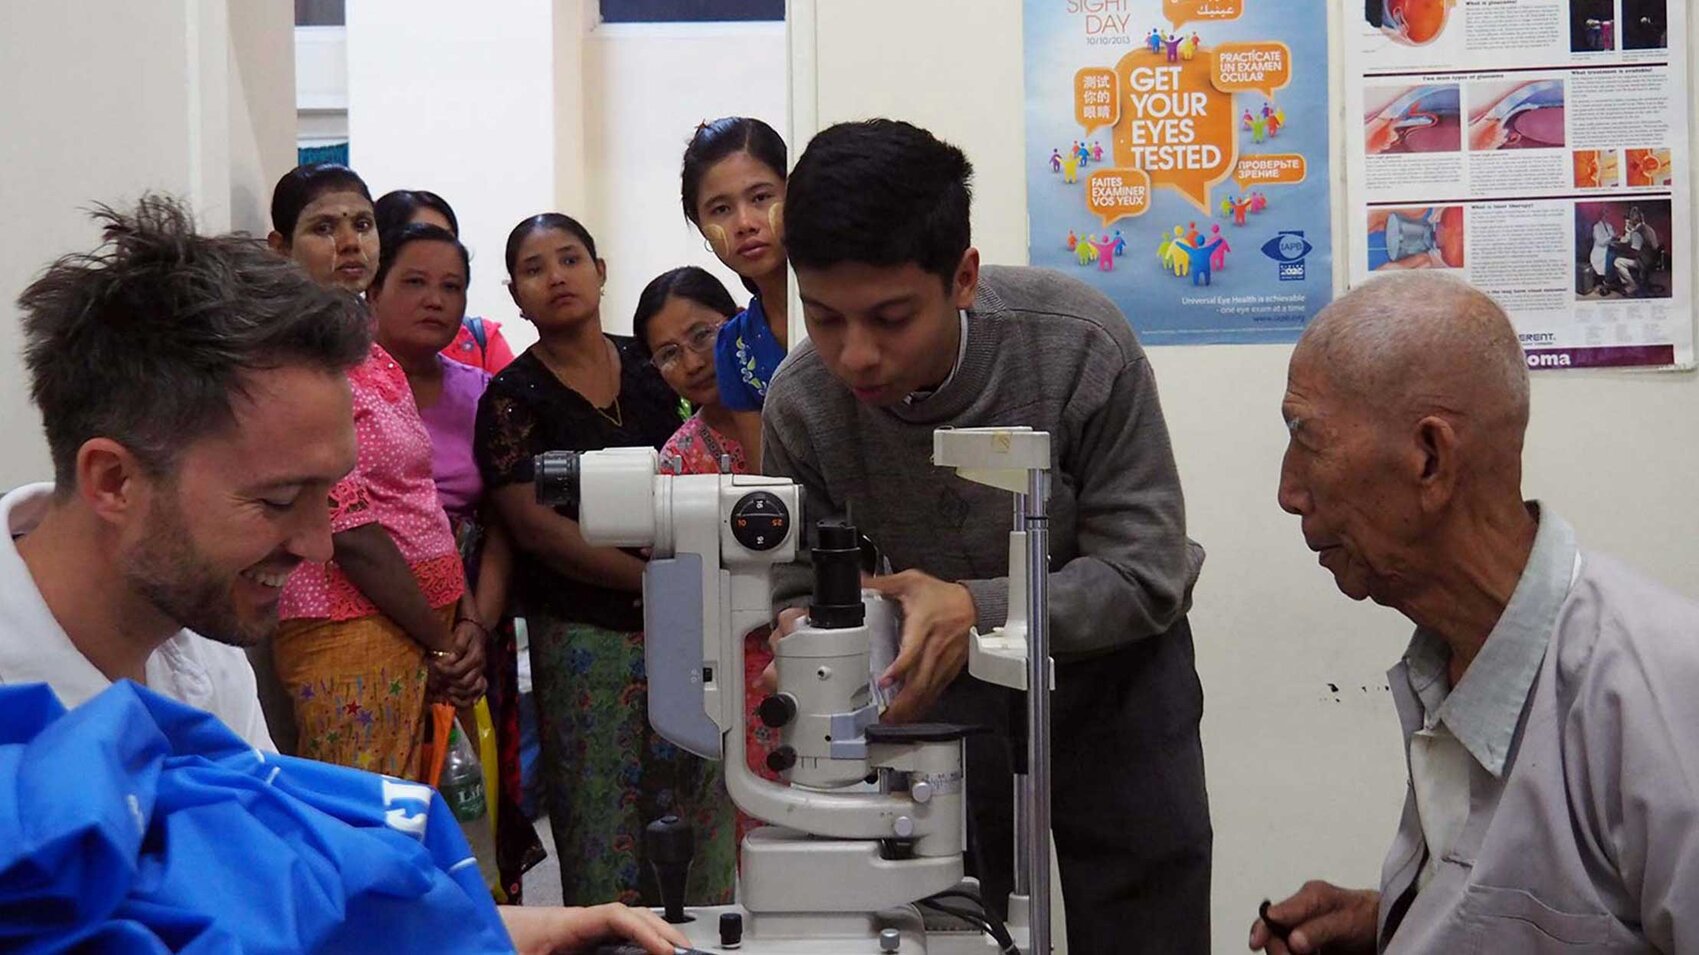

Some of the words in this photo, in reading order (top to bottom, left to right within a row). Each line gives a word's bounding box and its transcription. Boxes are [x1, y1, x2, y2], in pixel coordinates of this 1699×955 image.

[1067, 0, 1128, 13] SIGHT
[1085, 13, 1131, 34] DAY
[1086, 36, 1131, 45] 10/10/2013
[1219, 49, 1281, 62] PRACTÍCATE
[1220, 62, 1235, 73] UN
[1237, 61, 1282, 72] EXAMEN
[1129, 66, 1183, 92] GET
[1219, 71, 1264, 82] OCULAR
[1083, 89, 1110, 104] 你的
[1129, 92, 1208, 118] YOUR
[1132, 118, 1196, 145] EYES
[1131, 144, 1222, 171] TESTED
[1238, 159, 1300, 170] ПРОВЕРЬТЕ
[1237, 169, 1280, 179] ЗРЕНИЕ
[1092, 176, 1123, 187] FAITES
[1092, 186, 1145, 197] EXAMINER
[1092, 197, 1115, 207] VOS
[1116, 196, 1144, 206] YEUX
[1181, 295, 1216, 305] Universal
[1217, 295, 1231, 306] Eye
[1231, 294, 1257, 304] Health
[1527, 353, 1571, 367] oma
